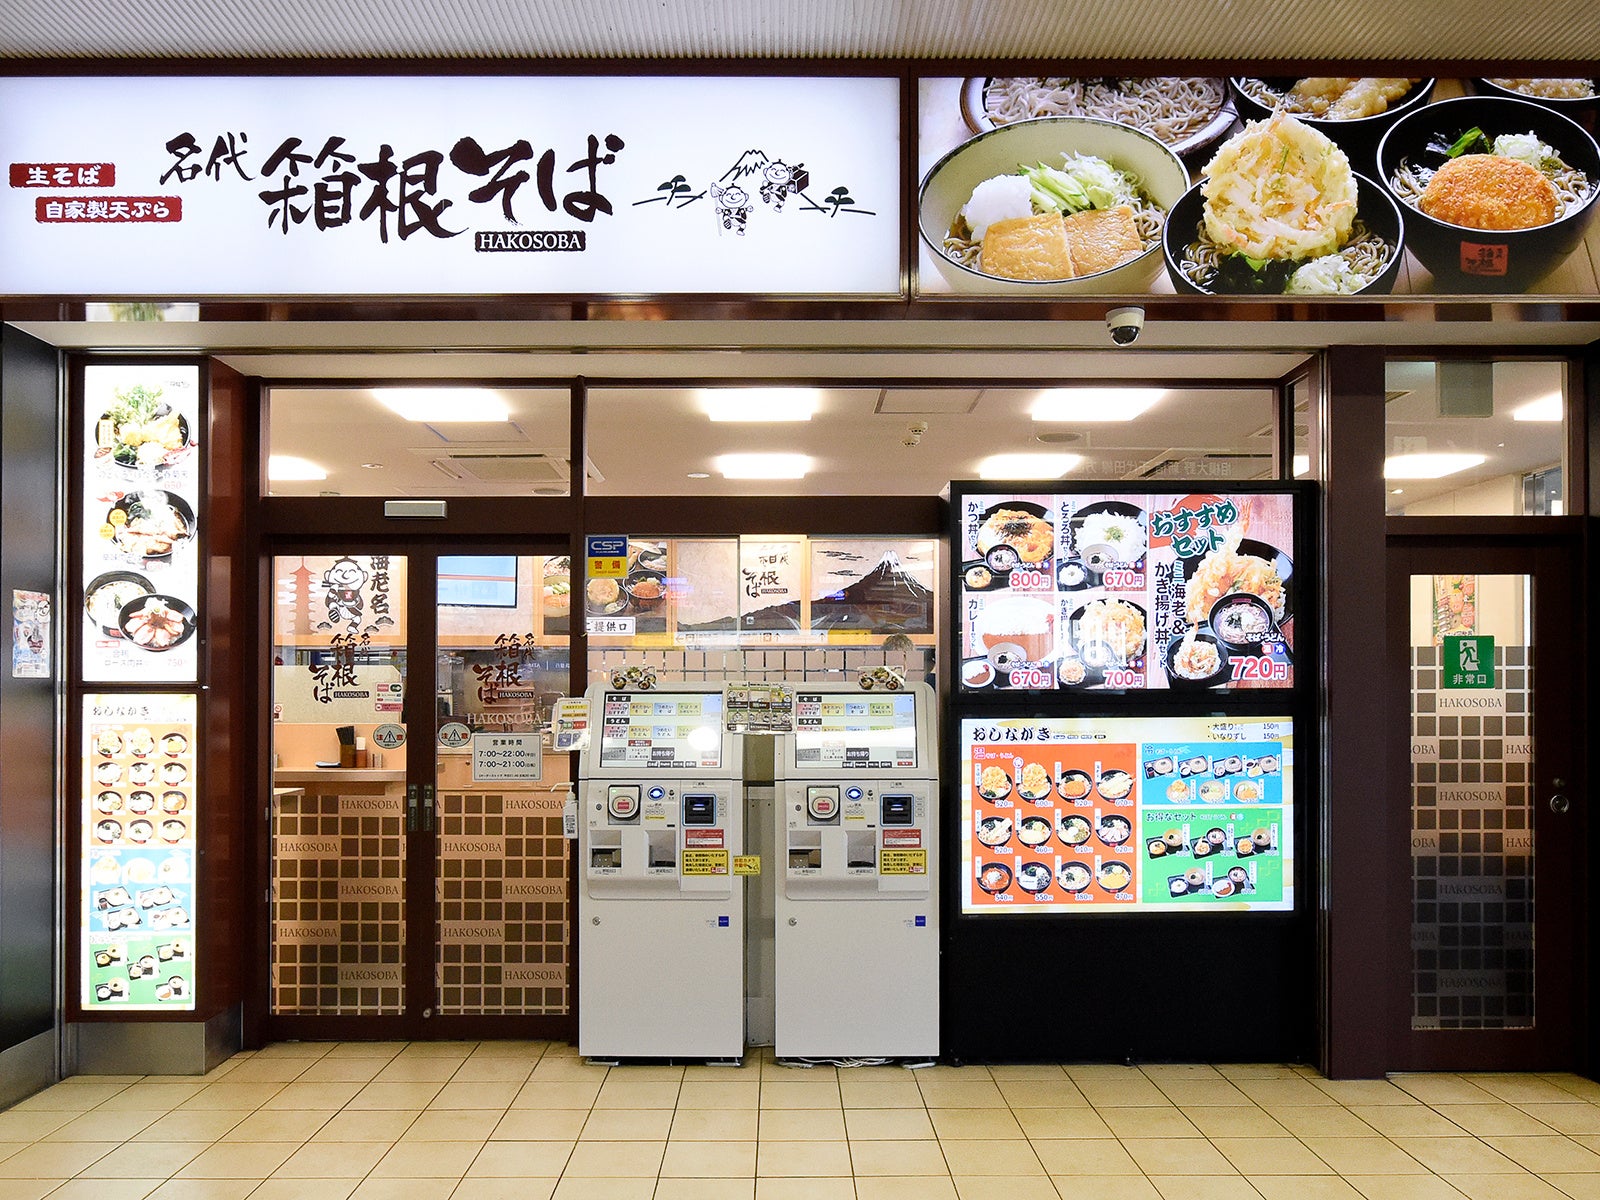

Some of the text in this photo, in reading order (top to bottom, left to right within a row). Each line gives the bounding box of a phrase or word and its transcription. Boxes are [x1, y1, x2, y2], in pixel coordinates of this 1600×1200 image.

[26, 165, 101, 186] 生そば
[159, 131, 624, 243] 名代 箱根そば
[45, 200, 171, 220] 自家製天ぷら
[479, 232, 582, 250] HAKOSOBA
[1152, 501, 1238, 536] おすすめ
[591, 541, 624, 550] CSP
[1172, 529, 1225, 556] セット
[1011, 573, 1049, 587] 800円
[1104, 572, 1143, 585] 670円
[370, 556, 390, 614] 海老名
[1230, 658, 1286, 678] 720円
[1011, 672, 1049, 685] 670円
[1105, 672, 1142, 685] 700円
[1453, 674, 1487, 684] 非常口
[1439, 698, 1502, 708] HAKOSOBA
[467, 713, 543, 725] HAKOSOBA
[973, 727, 1050, 741] おしながき
[1412, 744, 1436, 754] OBA
[1439, 791, 1502, 801] HAKOSOBA
[341, 800, 399, 809] HAKOSOBA
[506, 800, 563, 809] HAKOSOBA
[1146, 813, 1196, 822] お得なセット
[280, 843, 338, 852] HAKOSOBA
[444, 843, 502, 852] HAKOSOBA
[1412, 838, 1436, 848] OBA
[341, 886, 399, 895] HAKOSOBA
[505, 885, 563, 895] HAKOSOBA
[1440, 884, 1503, 894] HAKOSOBA
[280, 928, 338, 937] HAKOSOBA
[443, 928, 501, 937] HAKOSOBA
[341, 971, 399, 980] HAKOSOBA
[504, 971, 562, 980] HAKOSOBA
